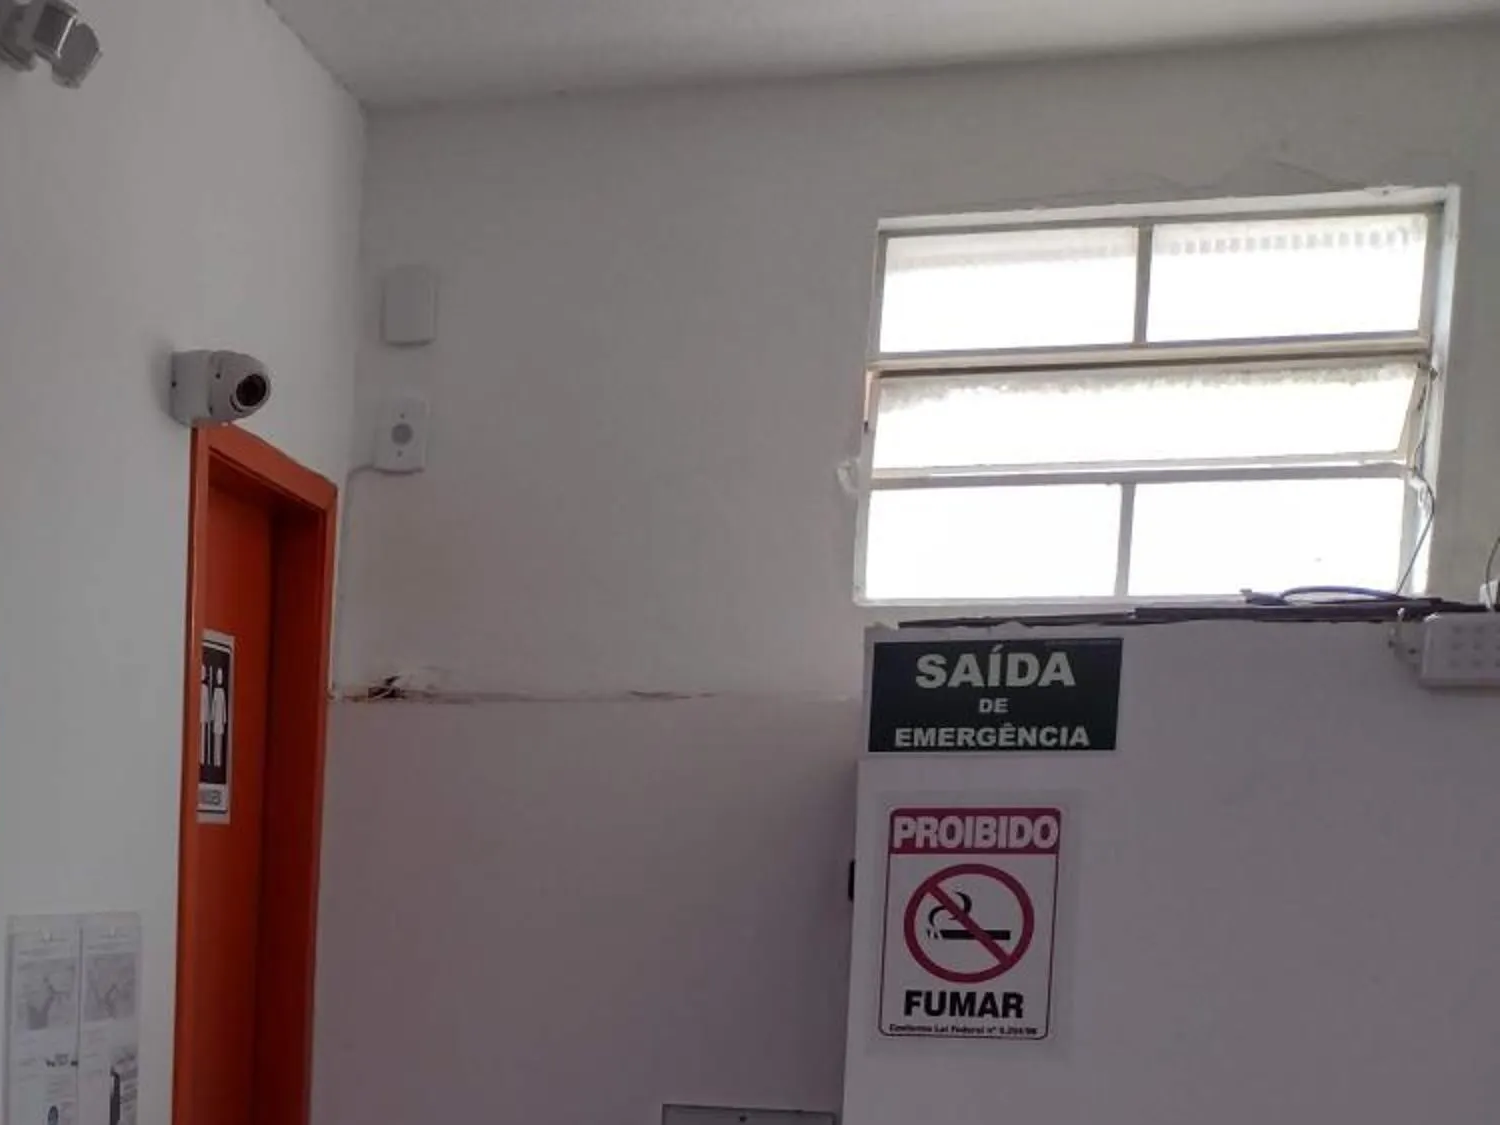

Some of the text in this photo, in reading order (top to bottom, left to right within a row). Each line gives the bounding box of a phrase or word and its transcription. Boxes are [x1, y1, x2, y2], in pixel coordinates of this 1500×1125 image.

[915, 643, 1077, 689] SAÍDA
[978, 697, 1010, 714] DE
[894, 722, 1091, 748] EMERGÊNCIA
[892, 814, 1060, 850] PROIBIDO
[904, 989, 1025, 1019] FUMAR
